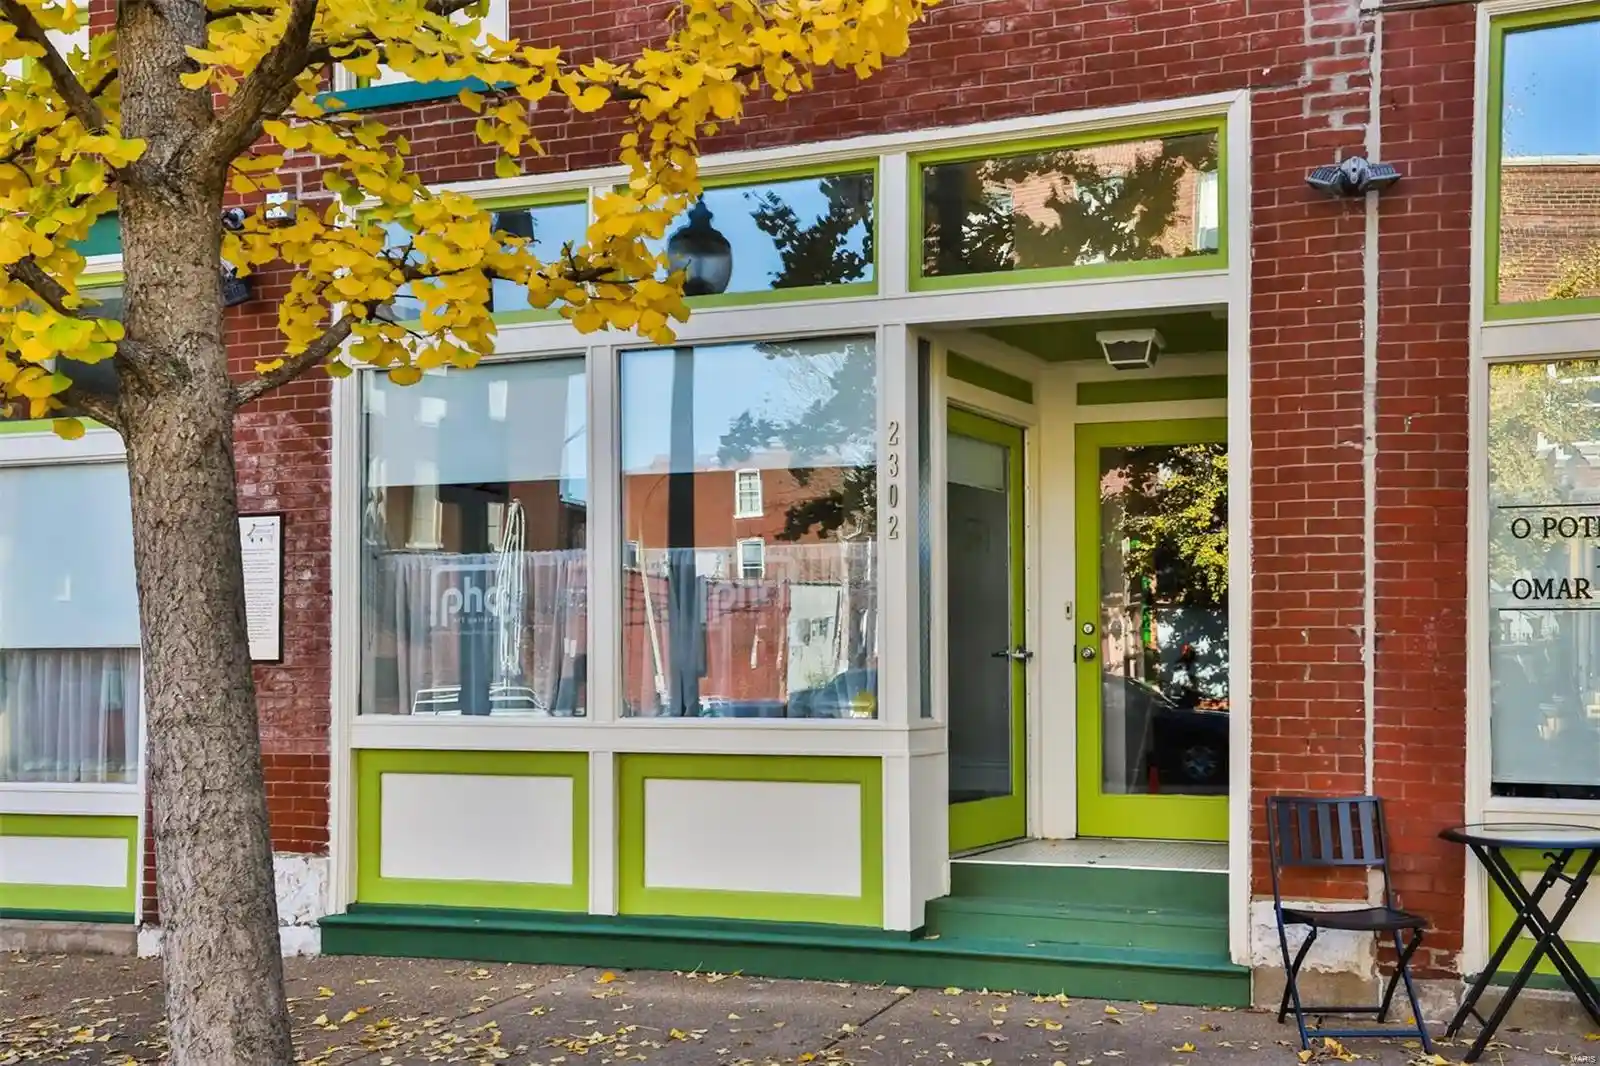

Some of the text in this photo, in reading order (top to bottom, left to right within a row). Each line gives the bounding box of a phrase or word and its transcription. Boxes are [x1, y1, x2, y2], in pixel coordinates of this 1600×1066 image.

[888, 420, 899, 539] 2302
[1511, 516, 1600, 539] O POT
[1512, 578, 1593, 600] OMAR
